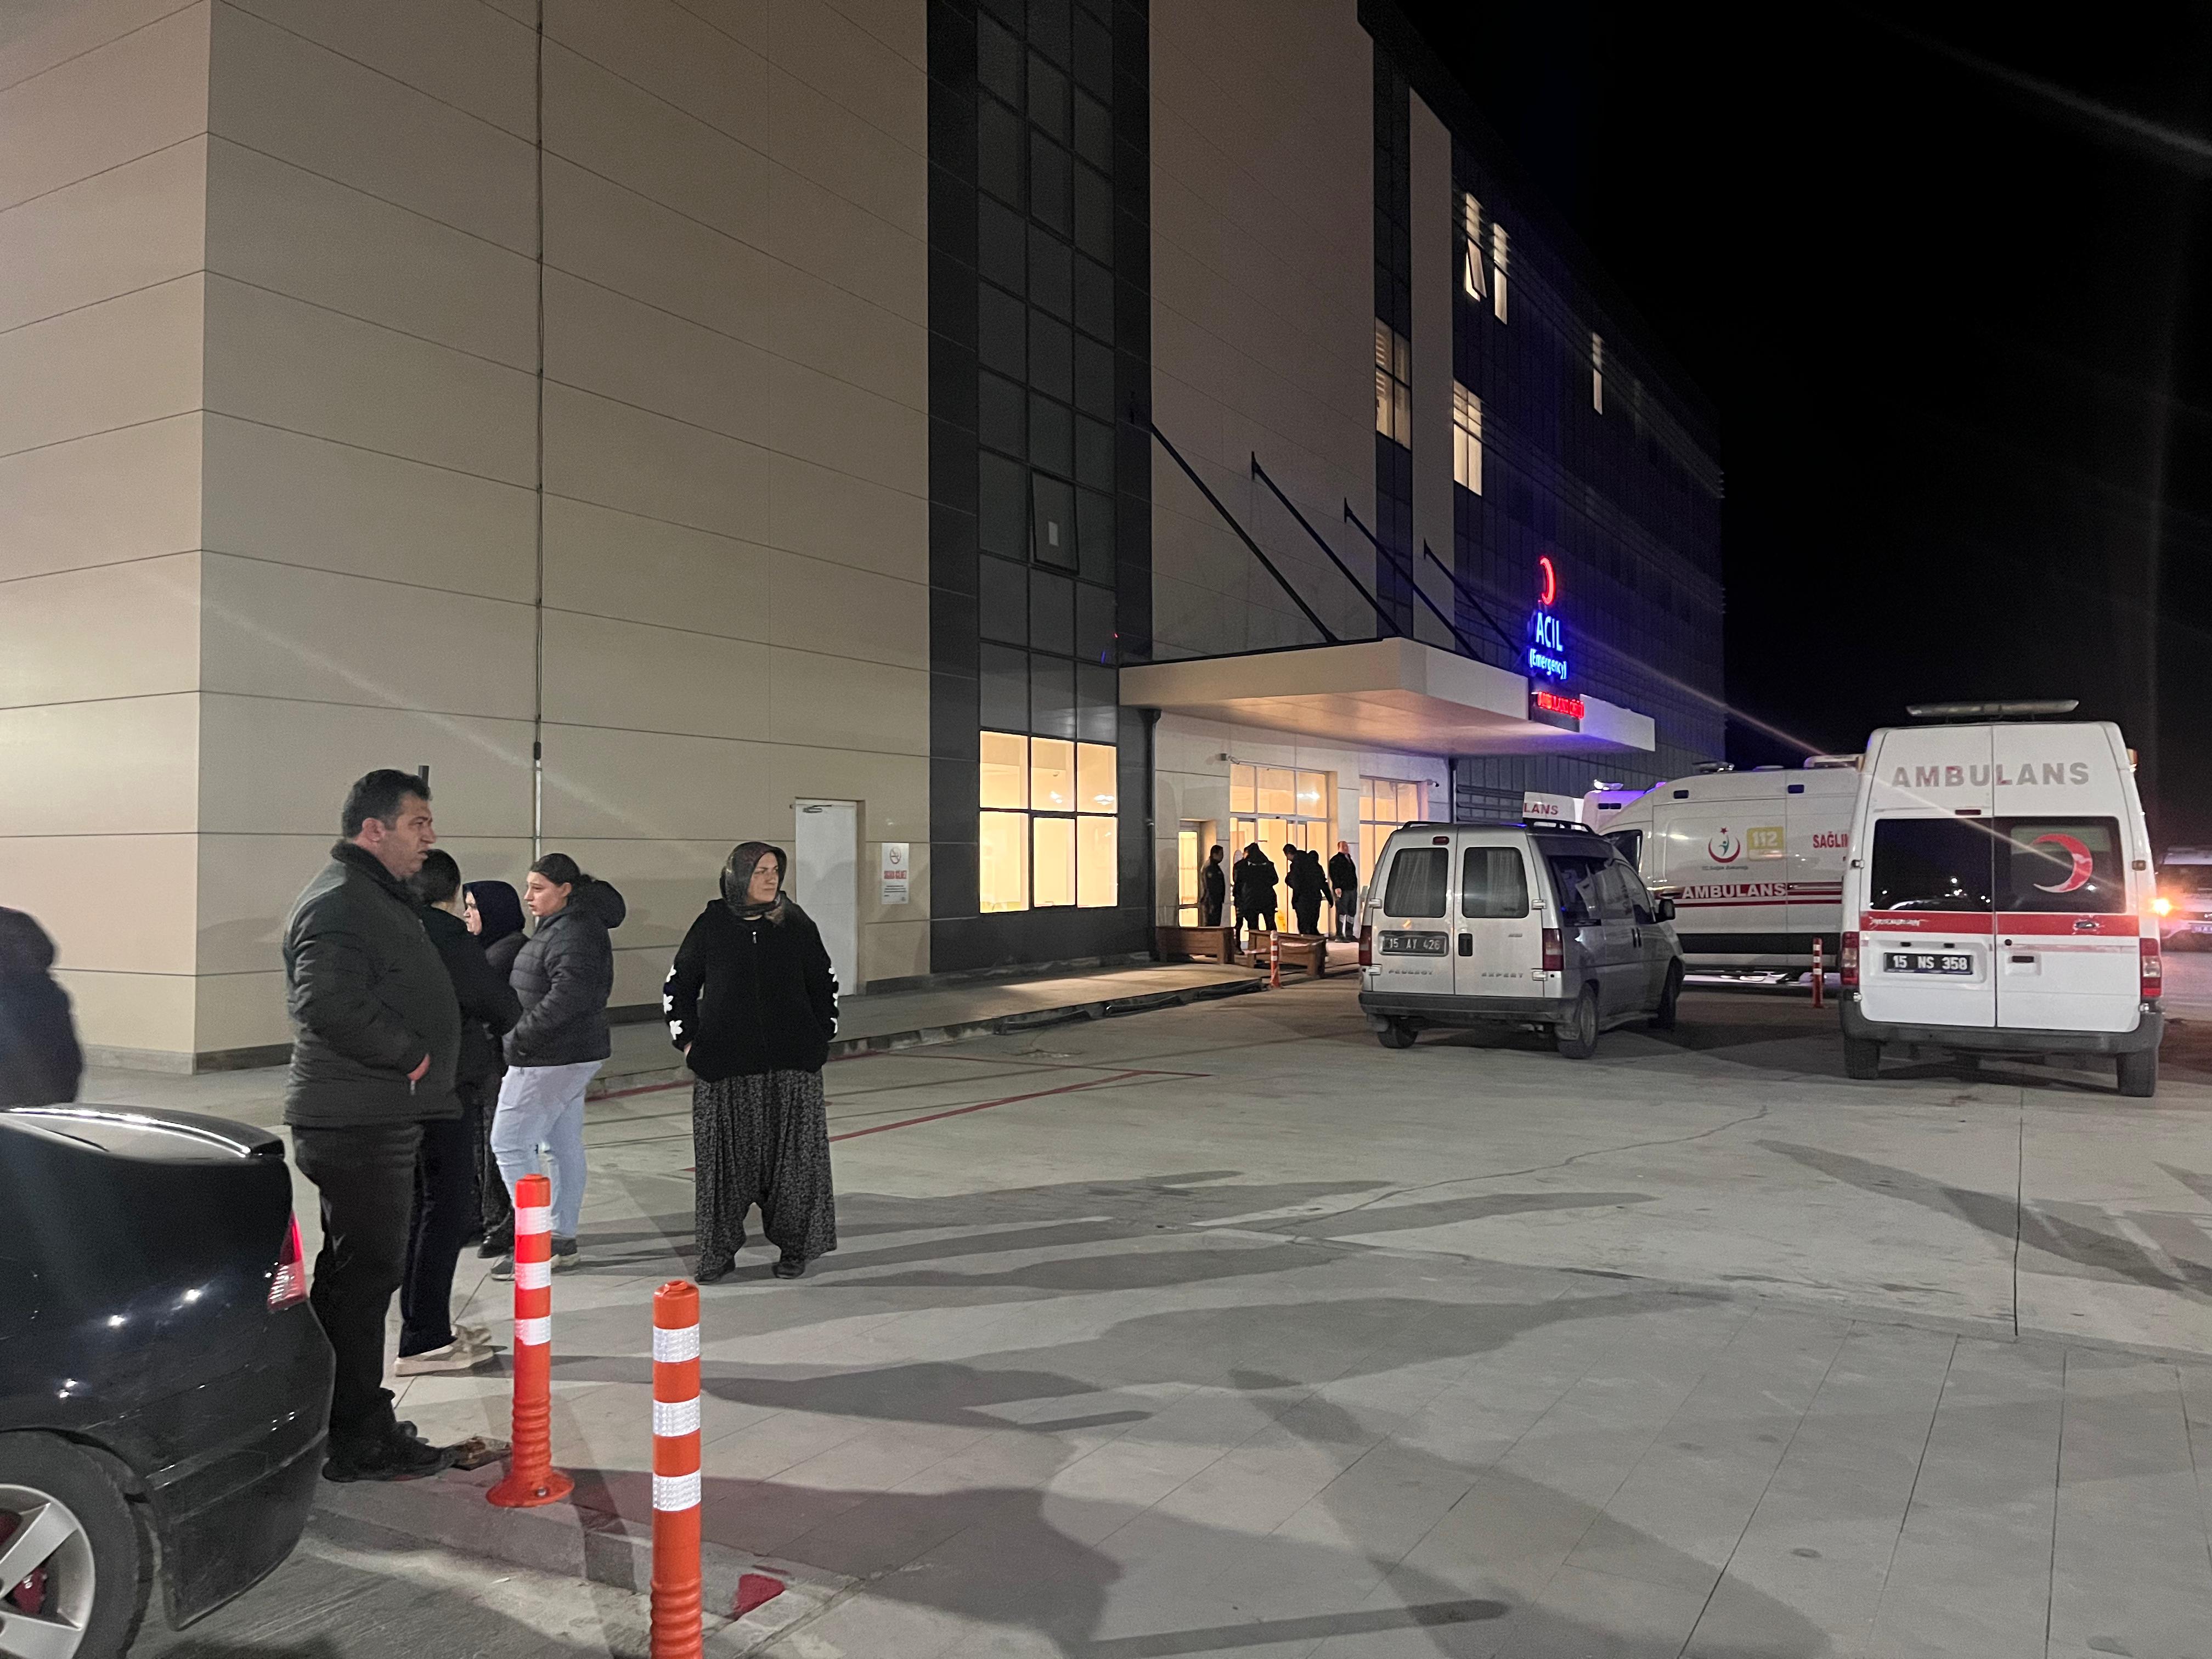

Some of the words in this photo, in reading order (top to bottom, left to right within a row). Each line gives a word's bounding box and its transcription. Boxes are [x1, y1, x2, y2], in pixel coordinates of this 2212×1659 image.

[1892, 761, 2090, 788] AMBULANS
[1523, 803, 1559, 815] LANS
[1752, 831, 1778, 847] 112
[1681, 882, 1787, 899] AMBULANS
[1389, 938, 1399, 949] 15
[1406, 939, 1417, 949] AY
[1423, 939, 1441, 950] 426
[1893, 955, 1908, 968] 15
[1917, 956, 1934, 969] NS
[1942, 957, 1968, 970] 358
